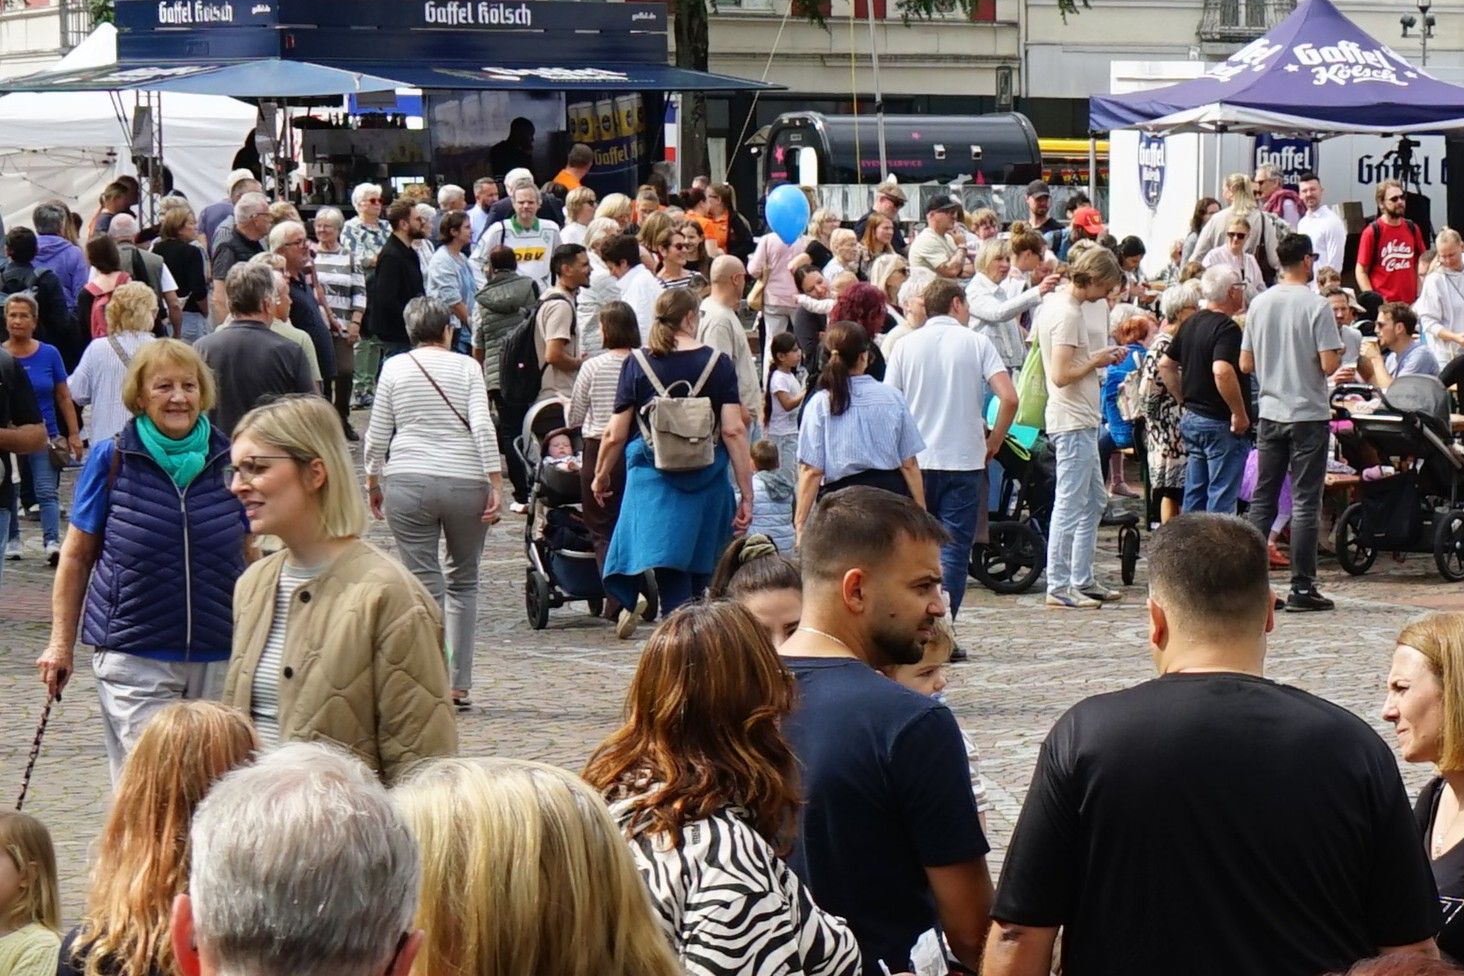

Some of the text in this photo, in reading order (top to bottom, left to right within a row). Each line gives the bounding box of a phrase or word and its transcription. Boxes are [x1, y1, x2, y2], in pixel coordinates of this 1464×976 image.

[159, 1, 192, 24] Gaffel
[425, 1, 531, 25] Gaffel Kölsch
[1293, 40, 1396, 71] Gaffel
[1313, 63, 1408, 86] Kölsch
[1256, 145, 1312, 171] Gaffel
